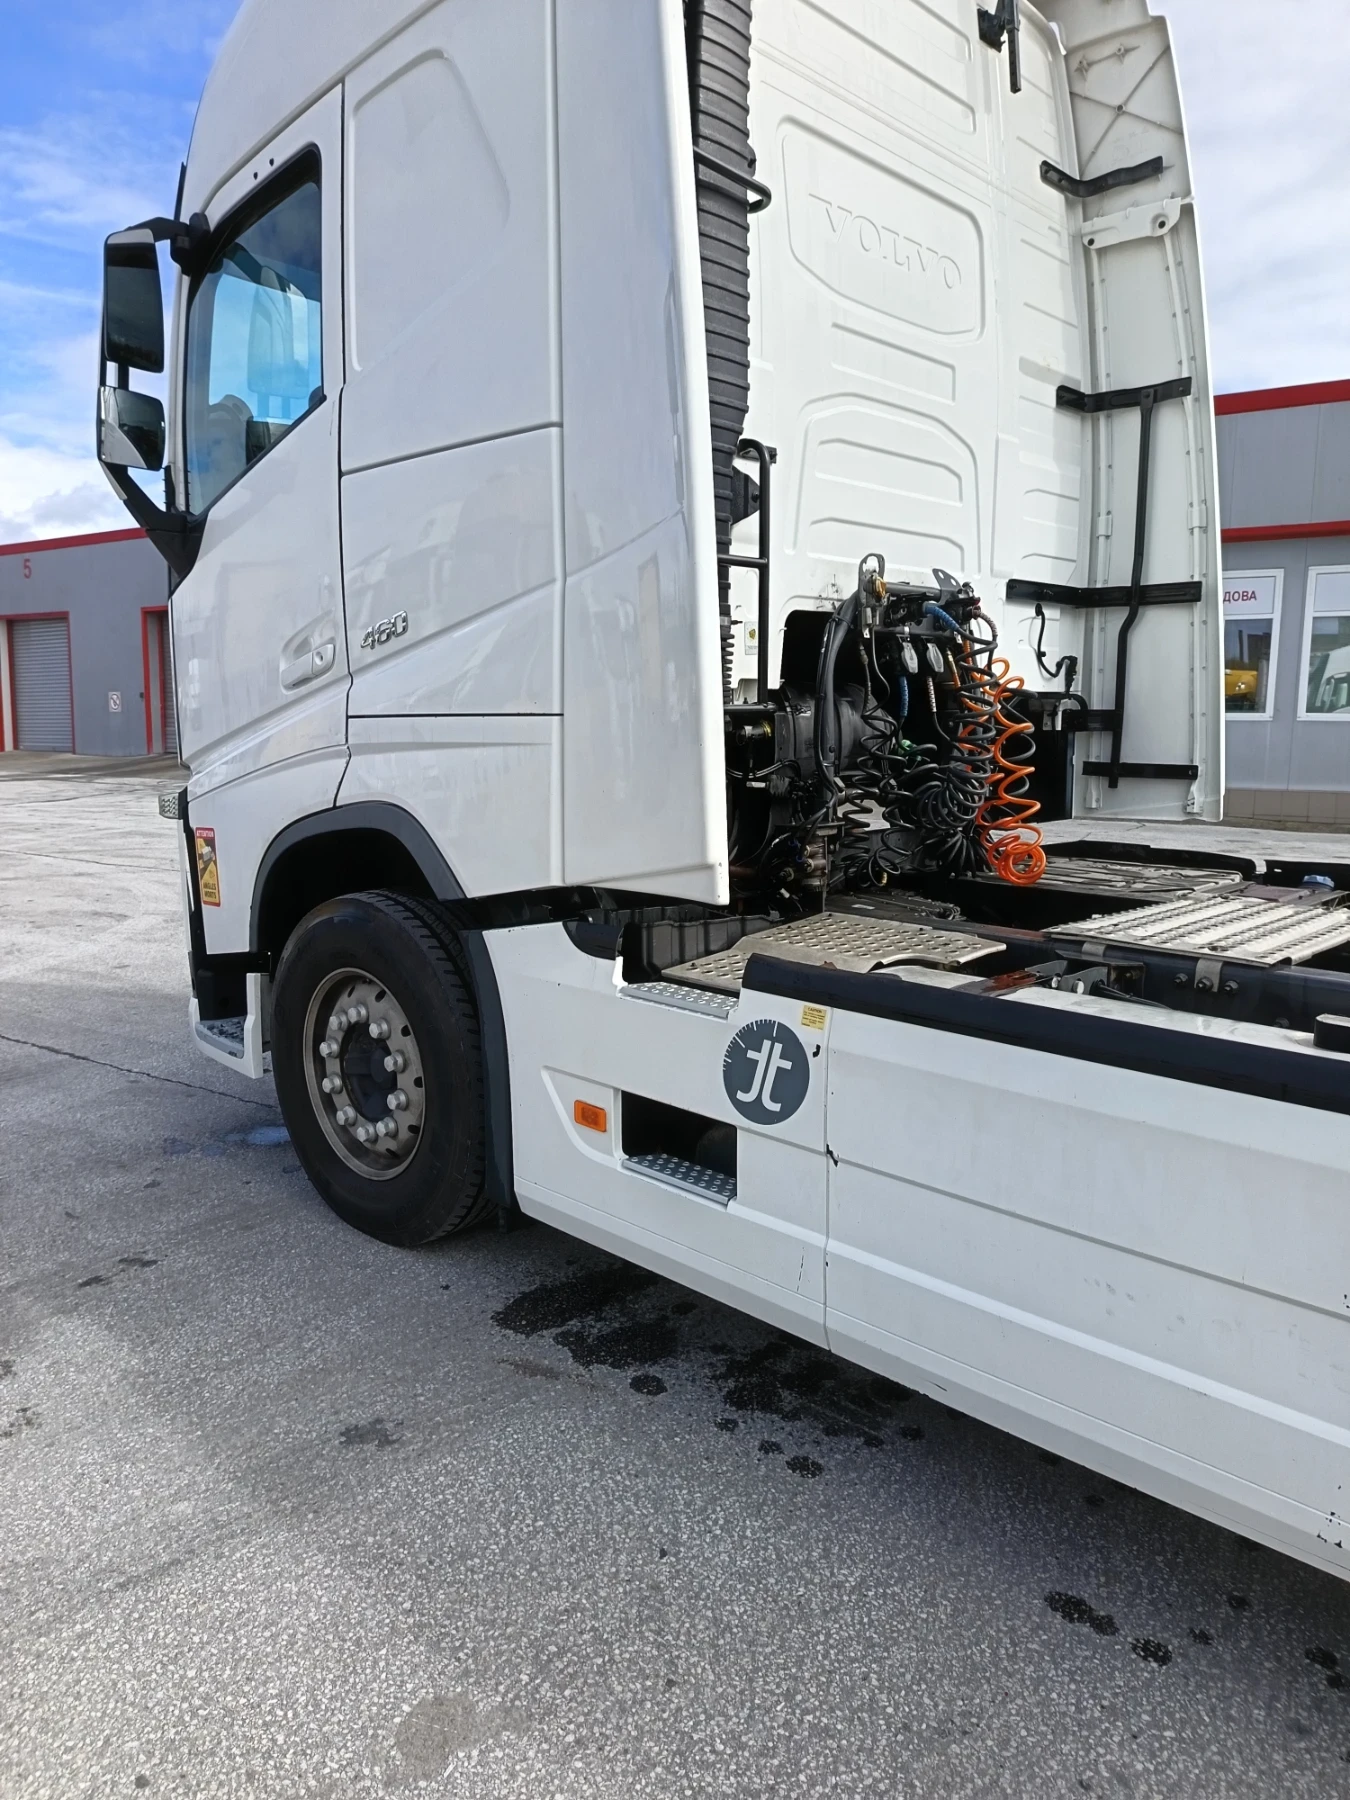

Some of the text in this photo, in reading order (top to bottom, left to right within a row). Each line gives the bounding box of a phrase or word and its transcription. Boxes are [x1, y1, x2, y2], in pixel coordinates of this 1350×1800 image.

[808, 192, 962, 290] VOLVO
[23, 559, 32, 579] 5
[1223, 590, 1257, 604] ДОВА
[361, 611, 409, 650] 460
